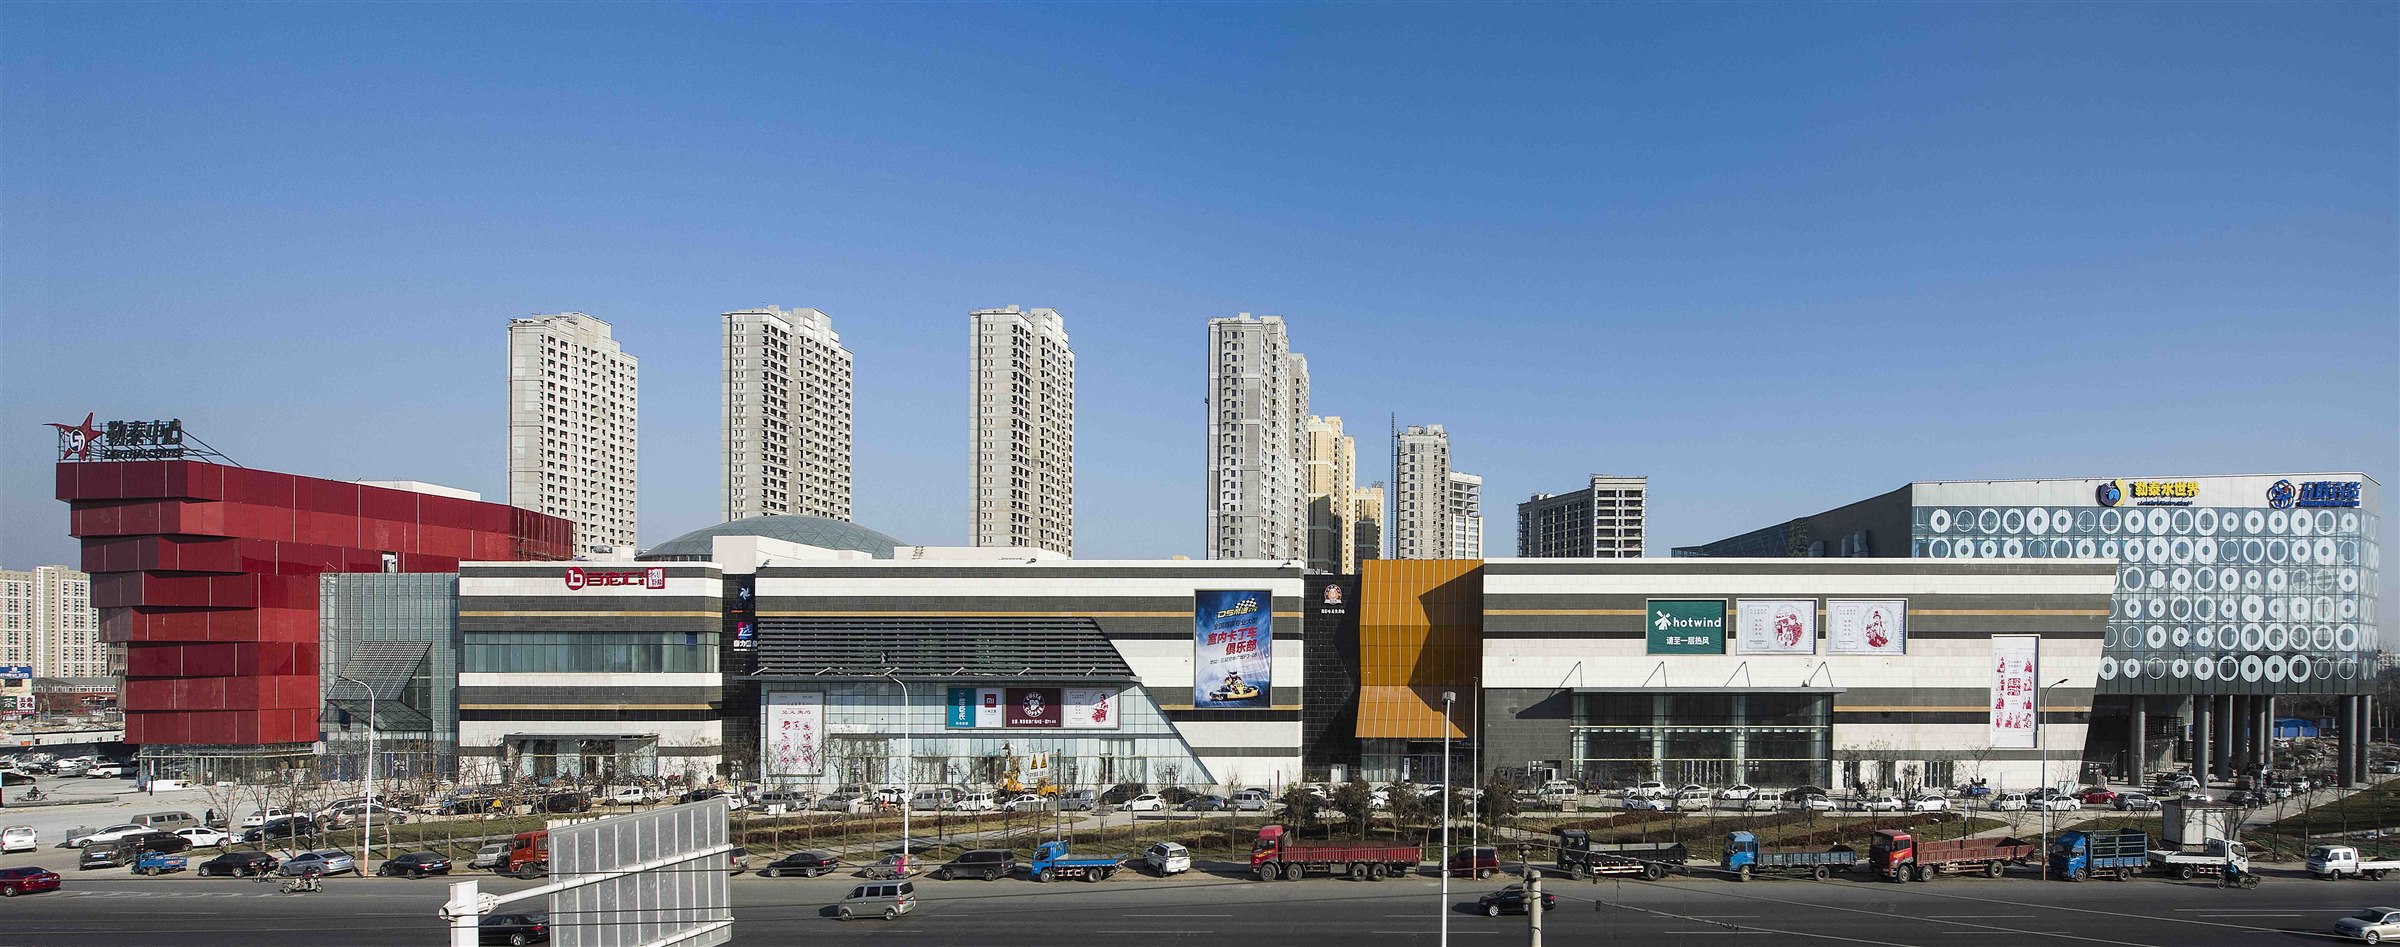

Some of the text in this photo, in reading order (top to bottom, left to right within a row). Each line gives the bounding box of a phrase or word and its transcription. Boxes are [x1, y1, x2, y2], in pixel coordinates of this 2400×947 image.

[2134, 481, 2200, 497] 勒泰水世界
[1673, 617, 1722, 627] hotwind
[1207, 626, 1258, 646] 室内卡丁车
[1666, 636, 1710, 645] 请至一层热风
[1226, 639, 1258, 656] 俱乐部
